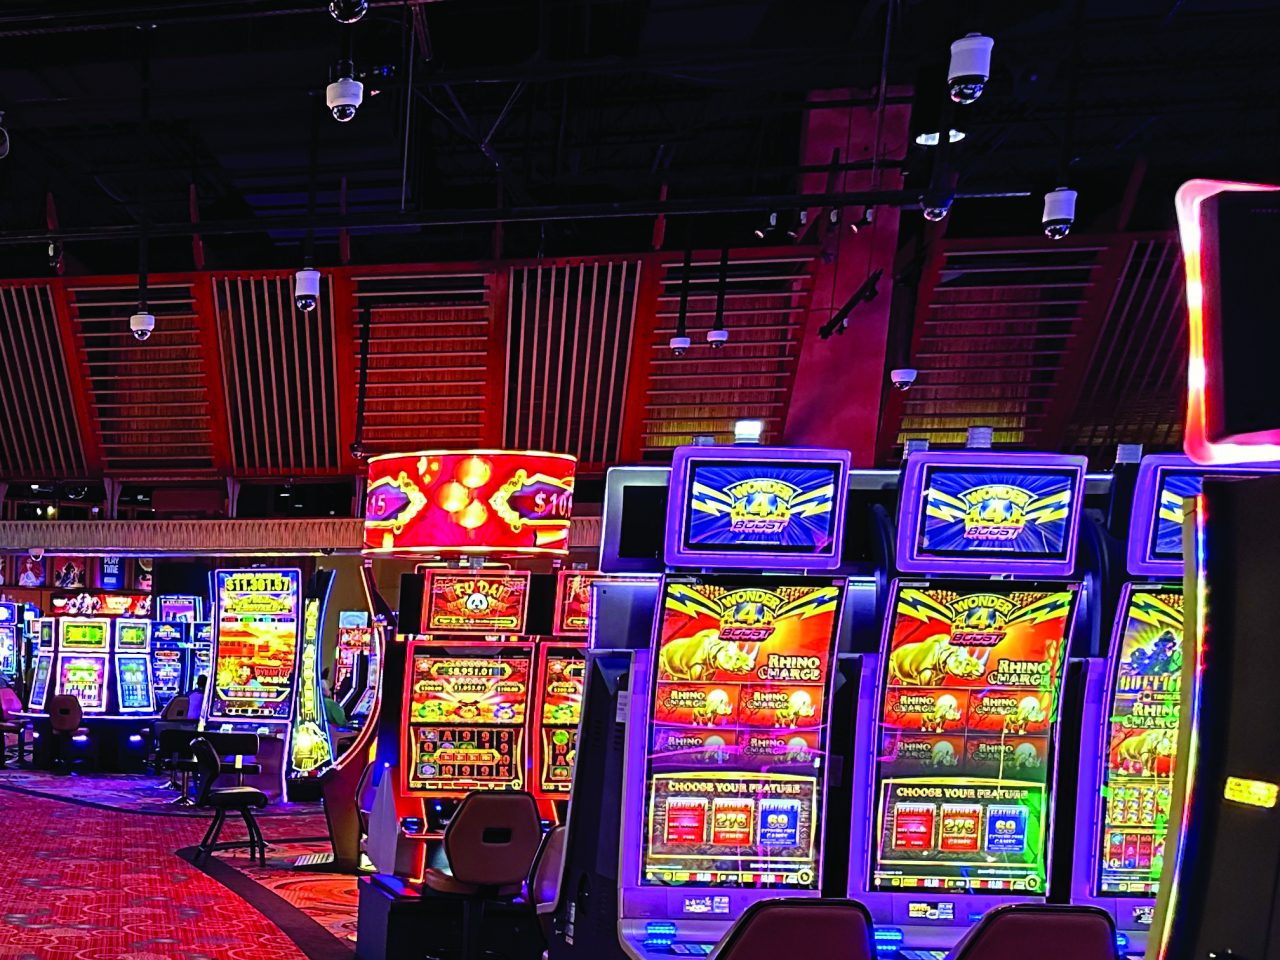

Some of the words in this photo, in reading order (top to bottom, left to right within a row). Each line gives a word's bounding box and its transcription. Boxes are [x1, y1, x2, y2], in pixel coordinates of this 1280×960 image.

[731, 481, 793, 500] WONDER
[966, 486, 1029, 508] WONDER
[749, 491, 772, 518] 4
[983, 501, 1006, 524] 4
[732, 519, 787, 532] BOOST
[966, 526, 1023, 539] BOOST
[454, 581, 474, 597] FU
[721, 590, 781, 612] WONDER
[953, 595, 1013, 615] WONDER
[735, 603, 759, 625] 4
[967, 607, 990, 630] 4
[721, 628, 775, 641] BOOST
[951, 632, 1006, 646] BOOST
[769, 654, 820, 669] RHINO
[999, 659, 1050, 675] RHINO
[758, 665, 820, 681] CHARGE
[988, 671, 1050, 687] CHARGE
[670, 690, 705, 701] RHINO
[753, 691, 788, 702] RHINO
[900, 695, 934, 705] RHINO
[983, 697, 1017, 707] RHINO
[1122, 715, 1180, 728] CHARG
[668, 781, 714, 792] CHOOSE
[716, 783, 747, 793] YOUR
[749, 784, 800, 794] FEATURE
[896, 787, 942, 797] CHOOSE
[944, 788, 976, 798] YOUR
[977, 789, 1028, 799] FEATURE
